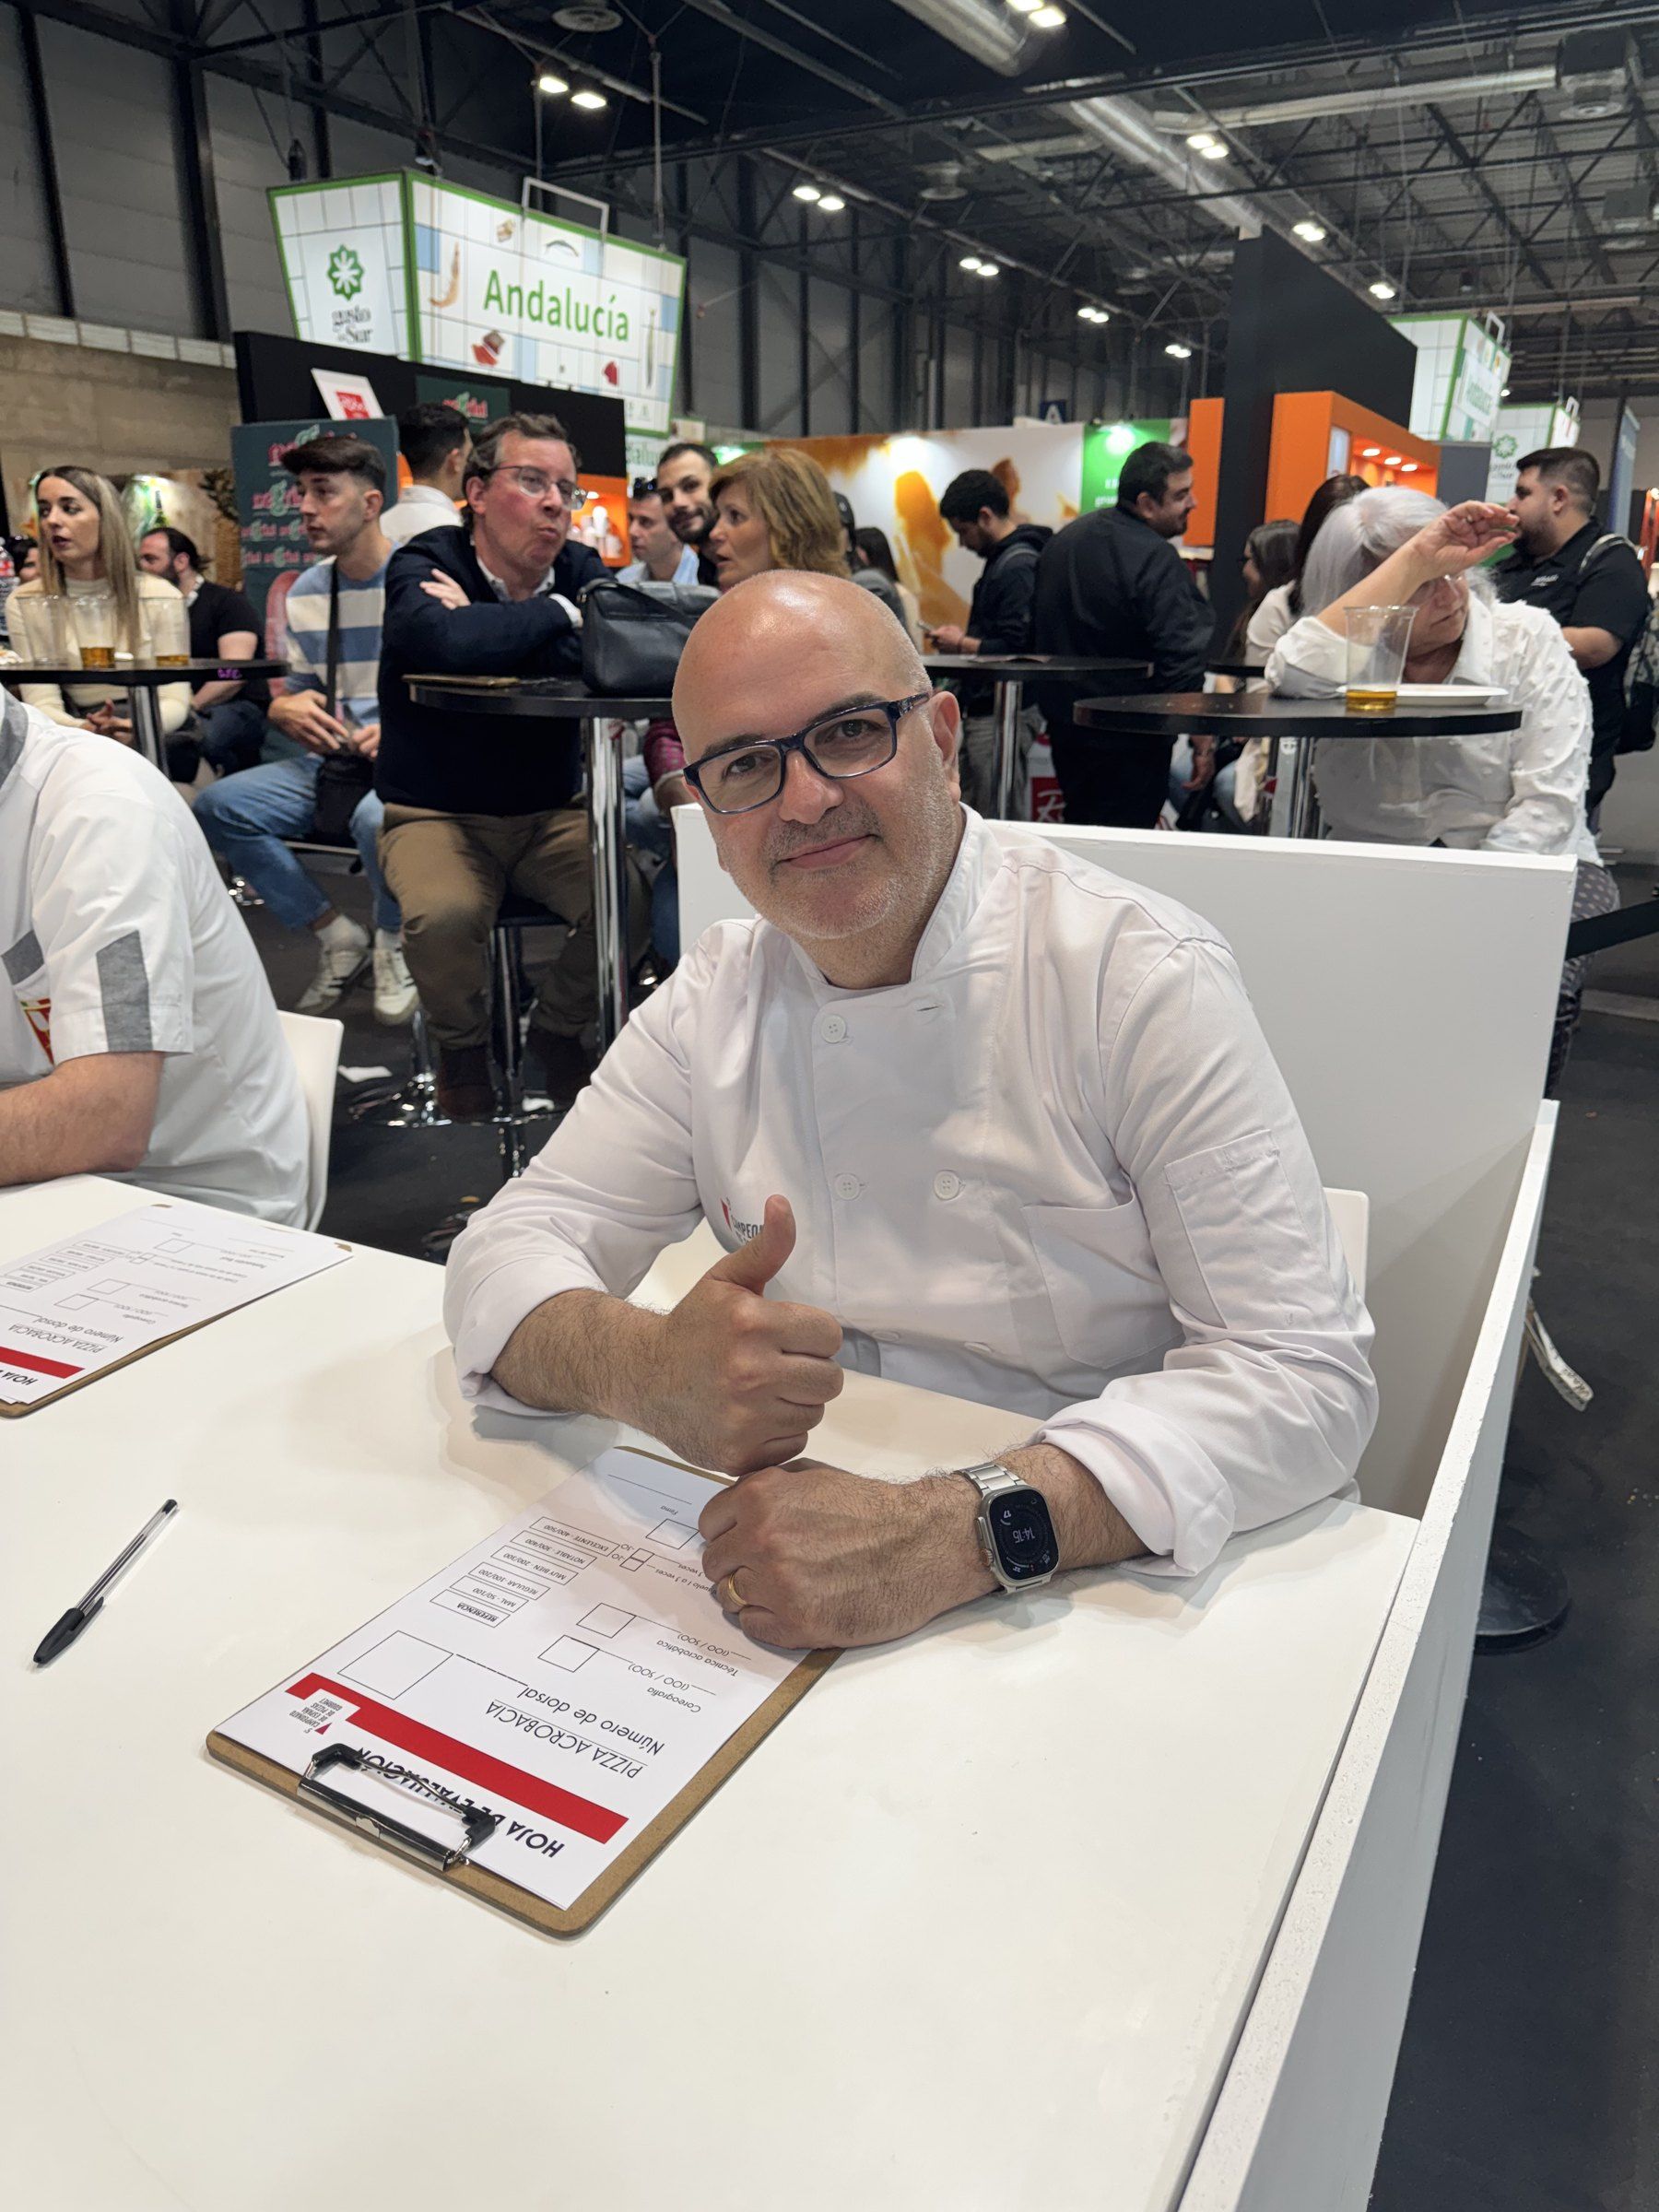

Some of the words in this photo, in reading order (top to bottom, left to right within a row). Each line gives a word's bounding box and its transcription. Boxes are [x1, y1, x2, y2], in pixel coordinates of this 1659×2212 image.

[483, 269, 629, 341] Andalucía
[731, 1215, 763, 1239] CAMPEO
[33, 1316, 68, 1329] dorsal
[68, 1324, 84, 1334] de
[8, 1324, 72, 1345] ACROBACIA
[85, 1328, 124, 1344] Número
[72, 1339, 104, 1353] PIZZA
[2, 1371, 38, 1386] HOJA
[573, 1536, 609, 1552] EXCELENTE
[554, 1550, 585, 1564] NOTABLE
[533, 1565, 550, 1573] BIEN
[550, 1571, 567, 1580] MUY
[655, 1568, 675, 1579] veces
[678, 1563, 698, 1574] veces
[473, 1587, 497, 1600] 50/100
[507, 1580, 538, 1595] REGULAR
[501, 1597, 516, 1607] MAL
[457, 1603, 497, 1622] REFERENCIA
[656, 1639, 703, 1662] acrobática
[704, 1657, 738, 1677] Técnica
[517, 1687, 570, 1713] dorsal
[574, 1709, 597, 1725] de
[485, 1701, 592, 1754] ACROBACIA
[600, 1720, 665, 1756] Número
[592, 1747, 643, 1778] PIZZA
[506, 1821, 565, 1858] HOJA
